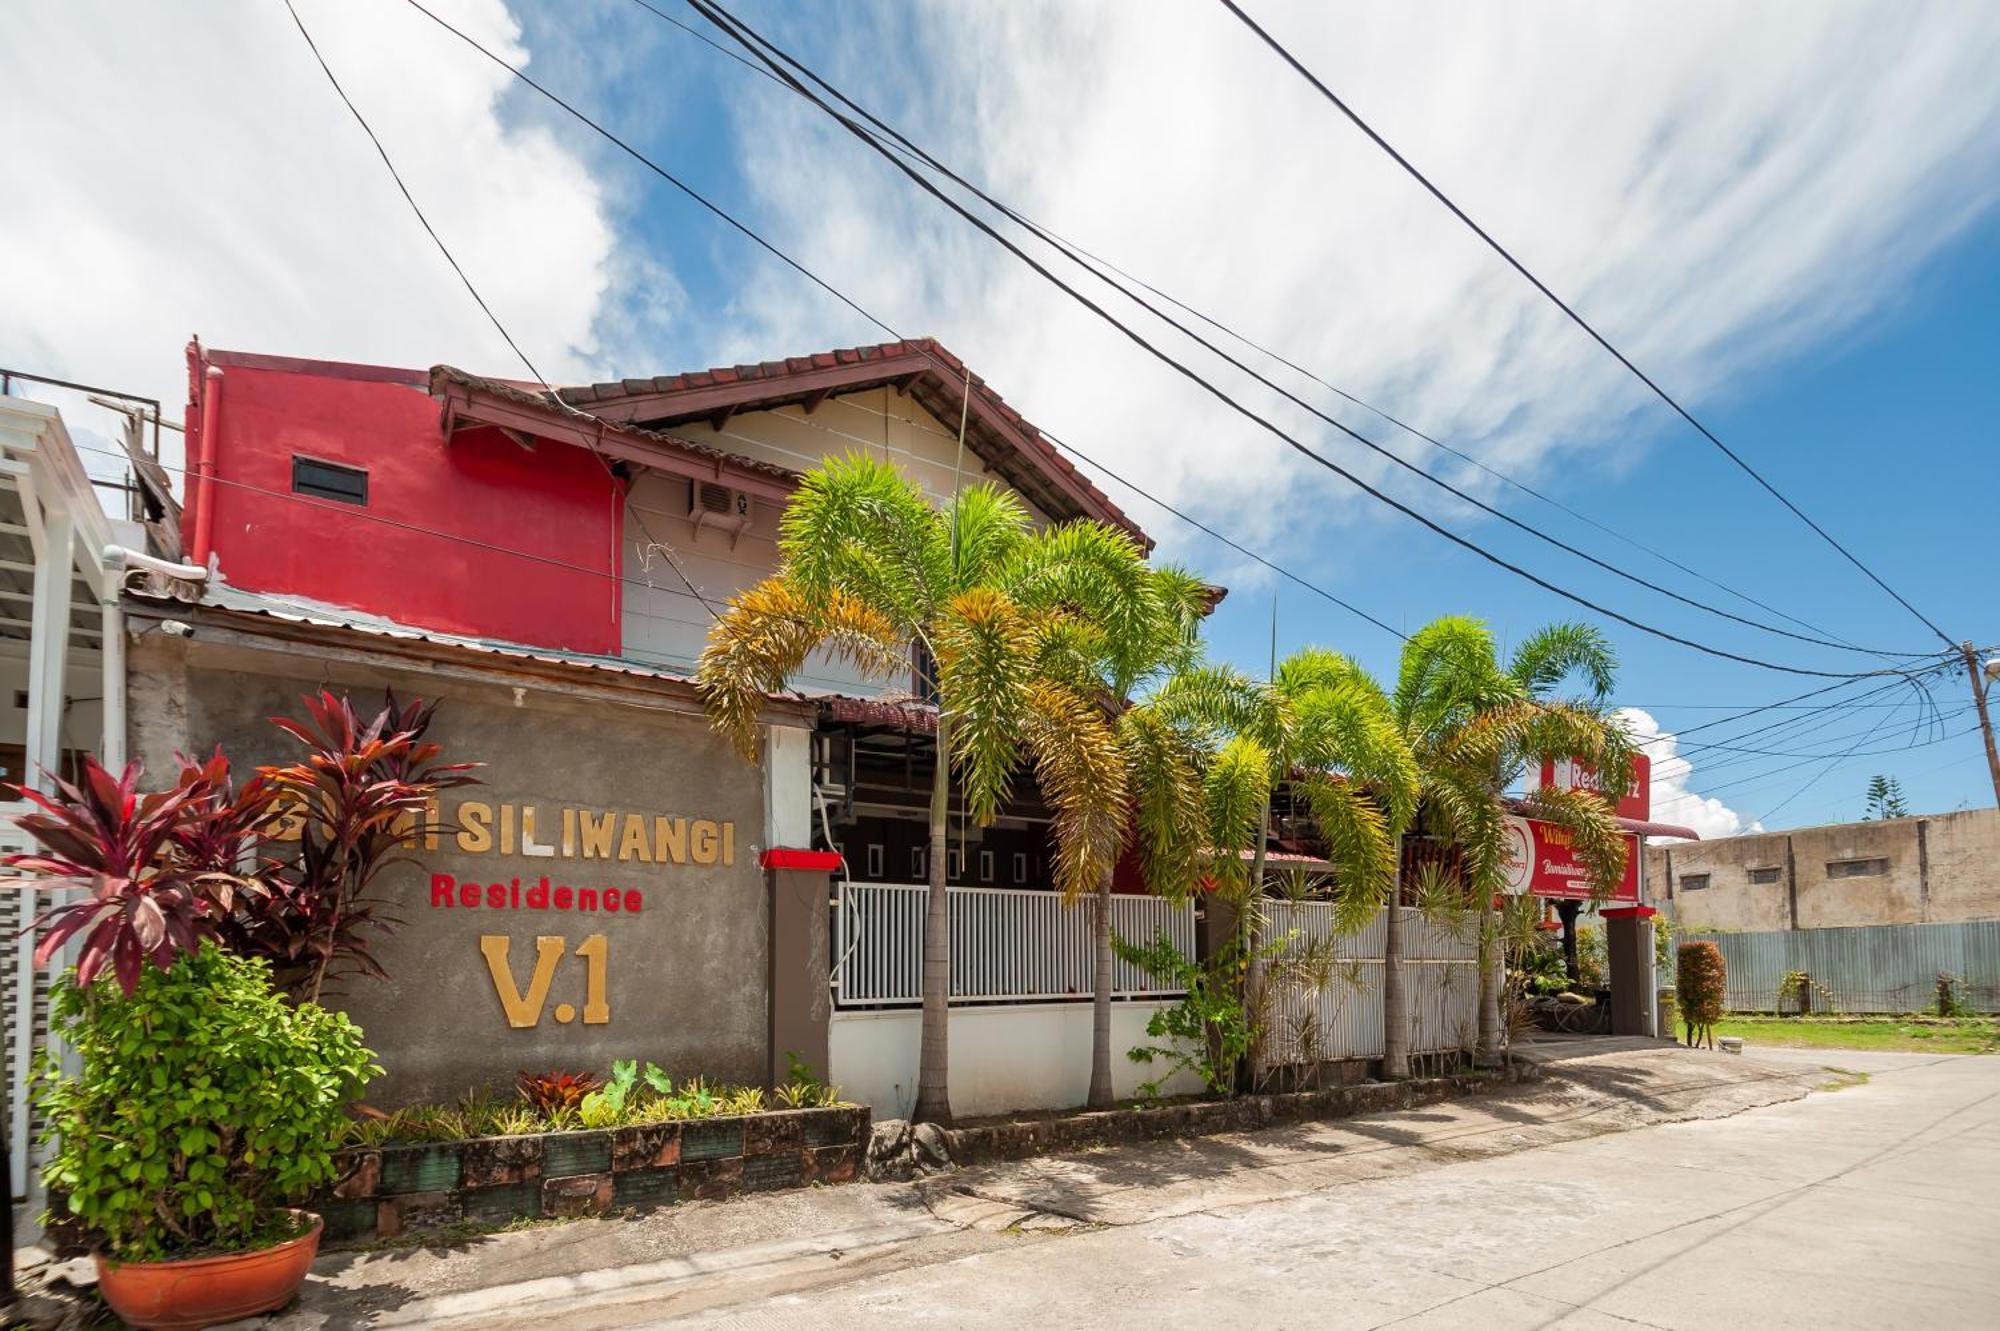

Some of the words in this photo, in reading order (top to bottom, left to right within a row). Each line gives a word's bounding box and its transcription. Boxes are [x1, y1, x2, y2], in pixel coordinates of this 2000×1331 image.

[1571, 763, 1640, 798] Redrz
[457, 801, 735, 866] SILIWANGI
[431, 872, 643, 912] Residence
[480, 934, 610, 1029] V.1
